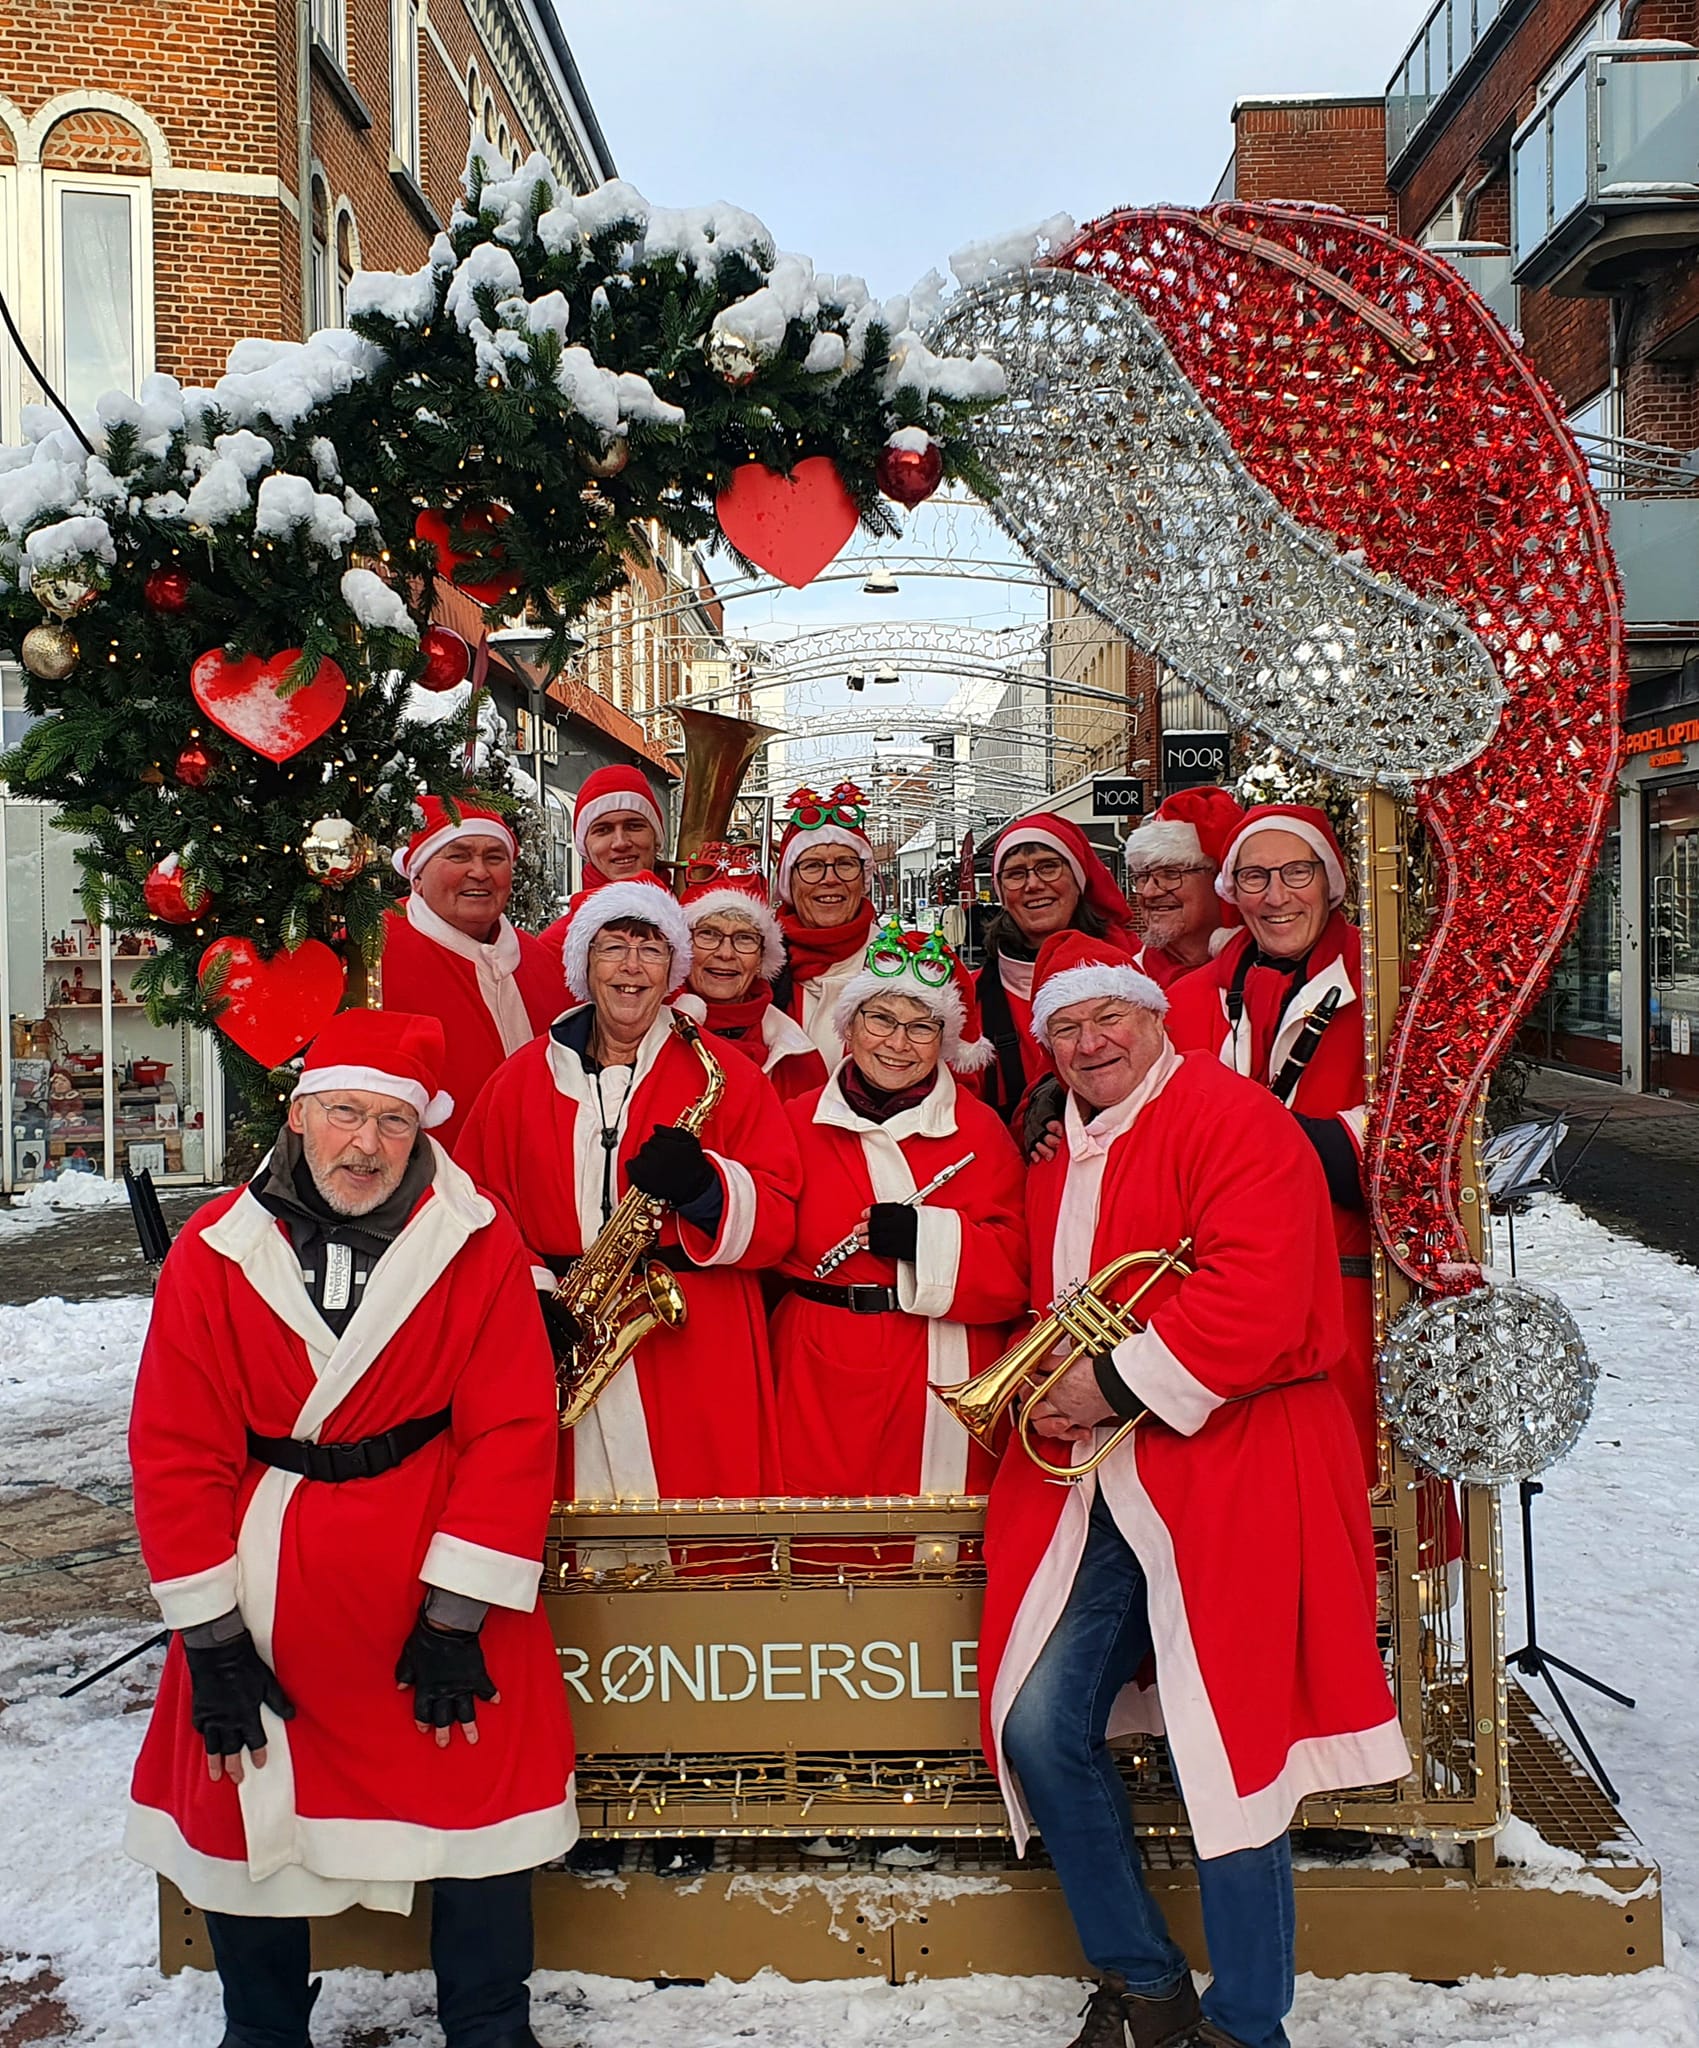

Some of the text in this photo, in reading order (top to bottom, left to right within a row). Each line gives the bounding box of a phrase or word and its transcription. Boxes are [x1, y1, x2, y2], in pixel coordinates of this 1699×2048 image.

[1667, 719, 1699, 745] OPTI
[1167, 747, 1225, 769] NOOR
[1096, 790, 1140, 806] NOOR
[555, 1640, 980, 1705] RØNDERSLE
